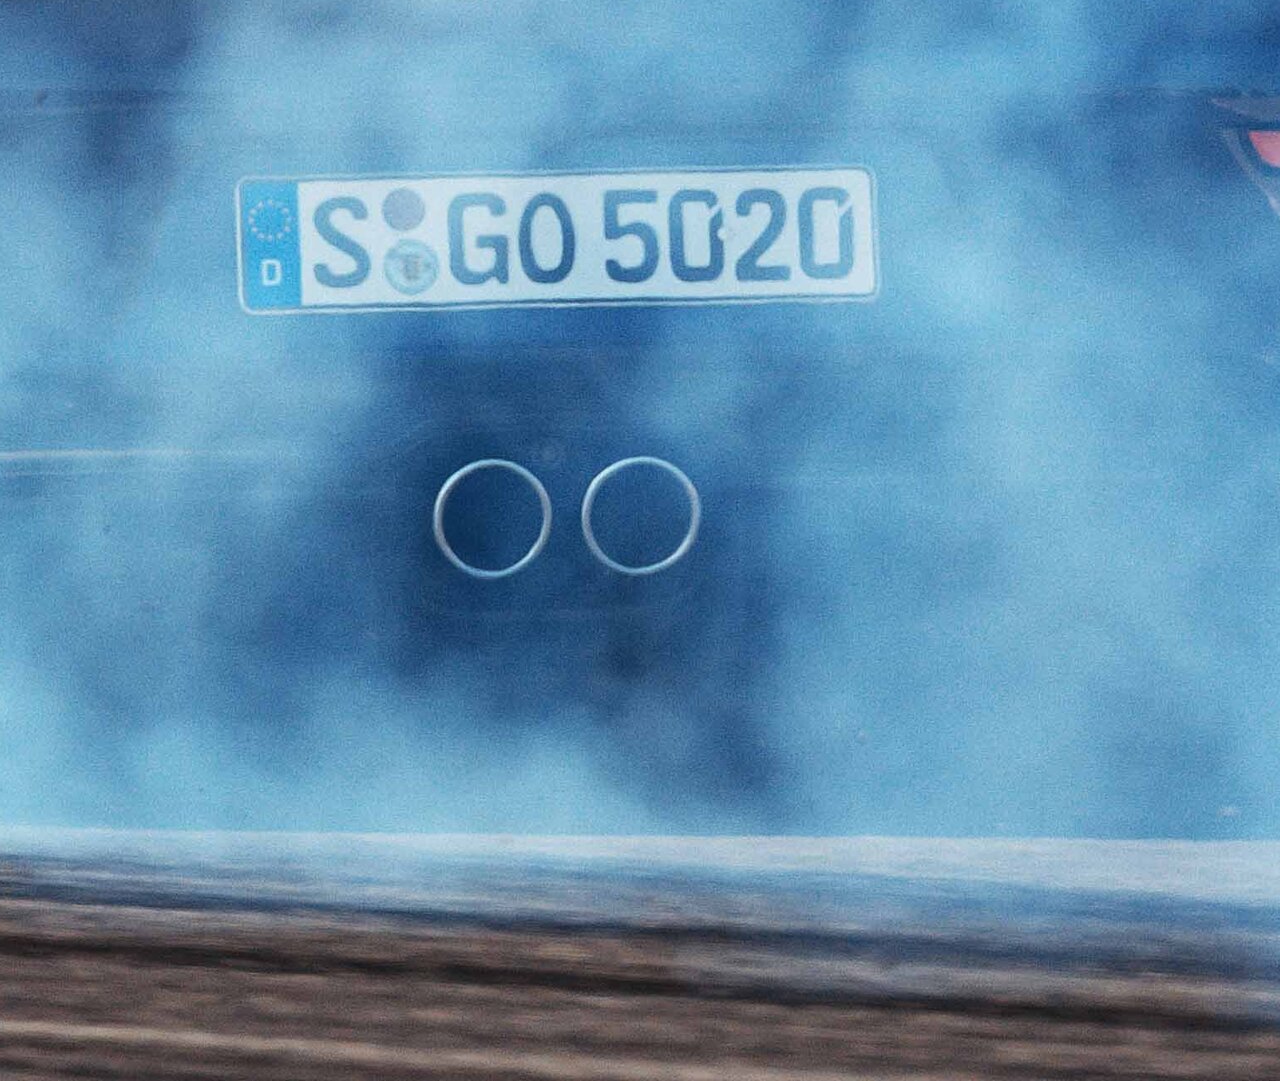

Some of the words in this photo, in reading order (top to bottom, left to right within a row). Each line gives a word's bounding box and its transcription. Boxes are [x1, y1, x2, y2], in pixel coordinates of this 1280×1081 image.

[312, 195, 371, 289] S
[446, 192, 576, 286] GO
[602, 186, 855, 284] 5020
[260, 258, 283, 287] D
